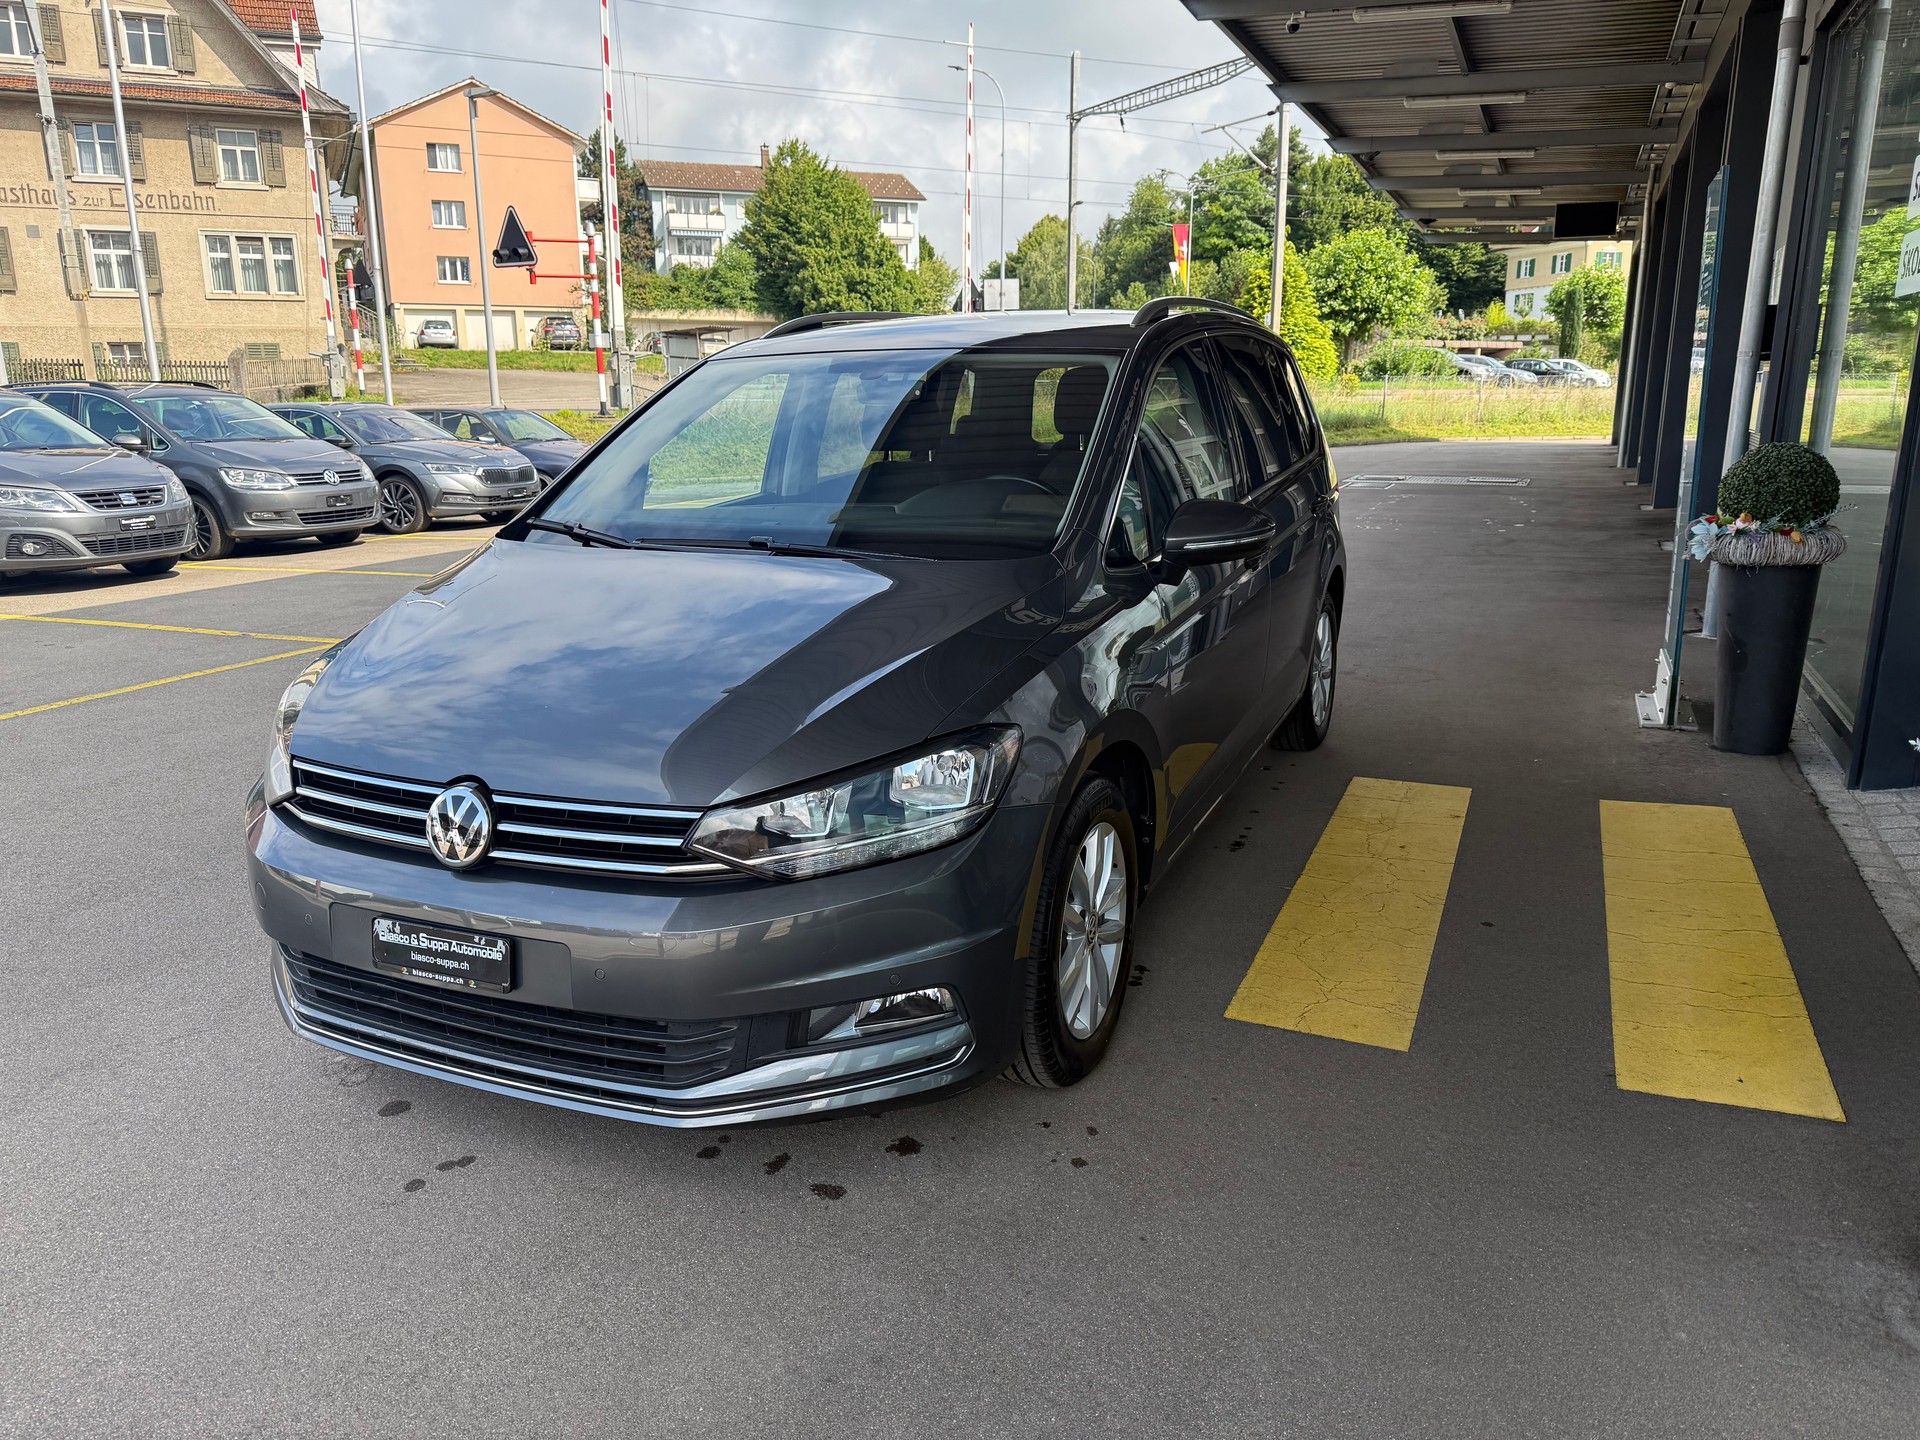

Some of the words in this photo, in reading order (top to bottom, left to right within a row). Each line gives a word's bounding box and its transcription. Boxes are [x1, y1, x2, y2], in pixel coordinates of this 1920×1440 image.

[0, 183, 77, 205] asthas
[83, 197, 105, 207] zur
[109, 188, 221, 211] Esenbahn.
[379, 930, 410, 945] Biasco
[411, 933, 419, 946] &
[419, 933, 449, 952] Suppa
[450, 941, 503, 961] Automobile
[411, 950, 470, 971] biasco-suppa.ch
[412, 968, 464, 984] biasco-suppa.ch
